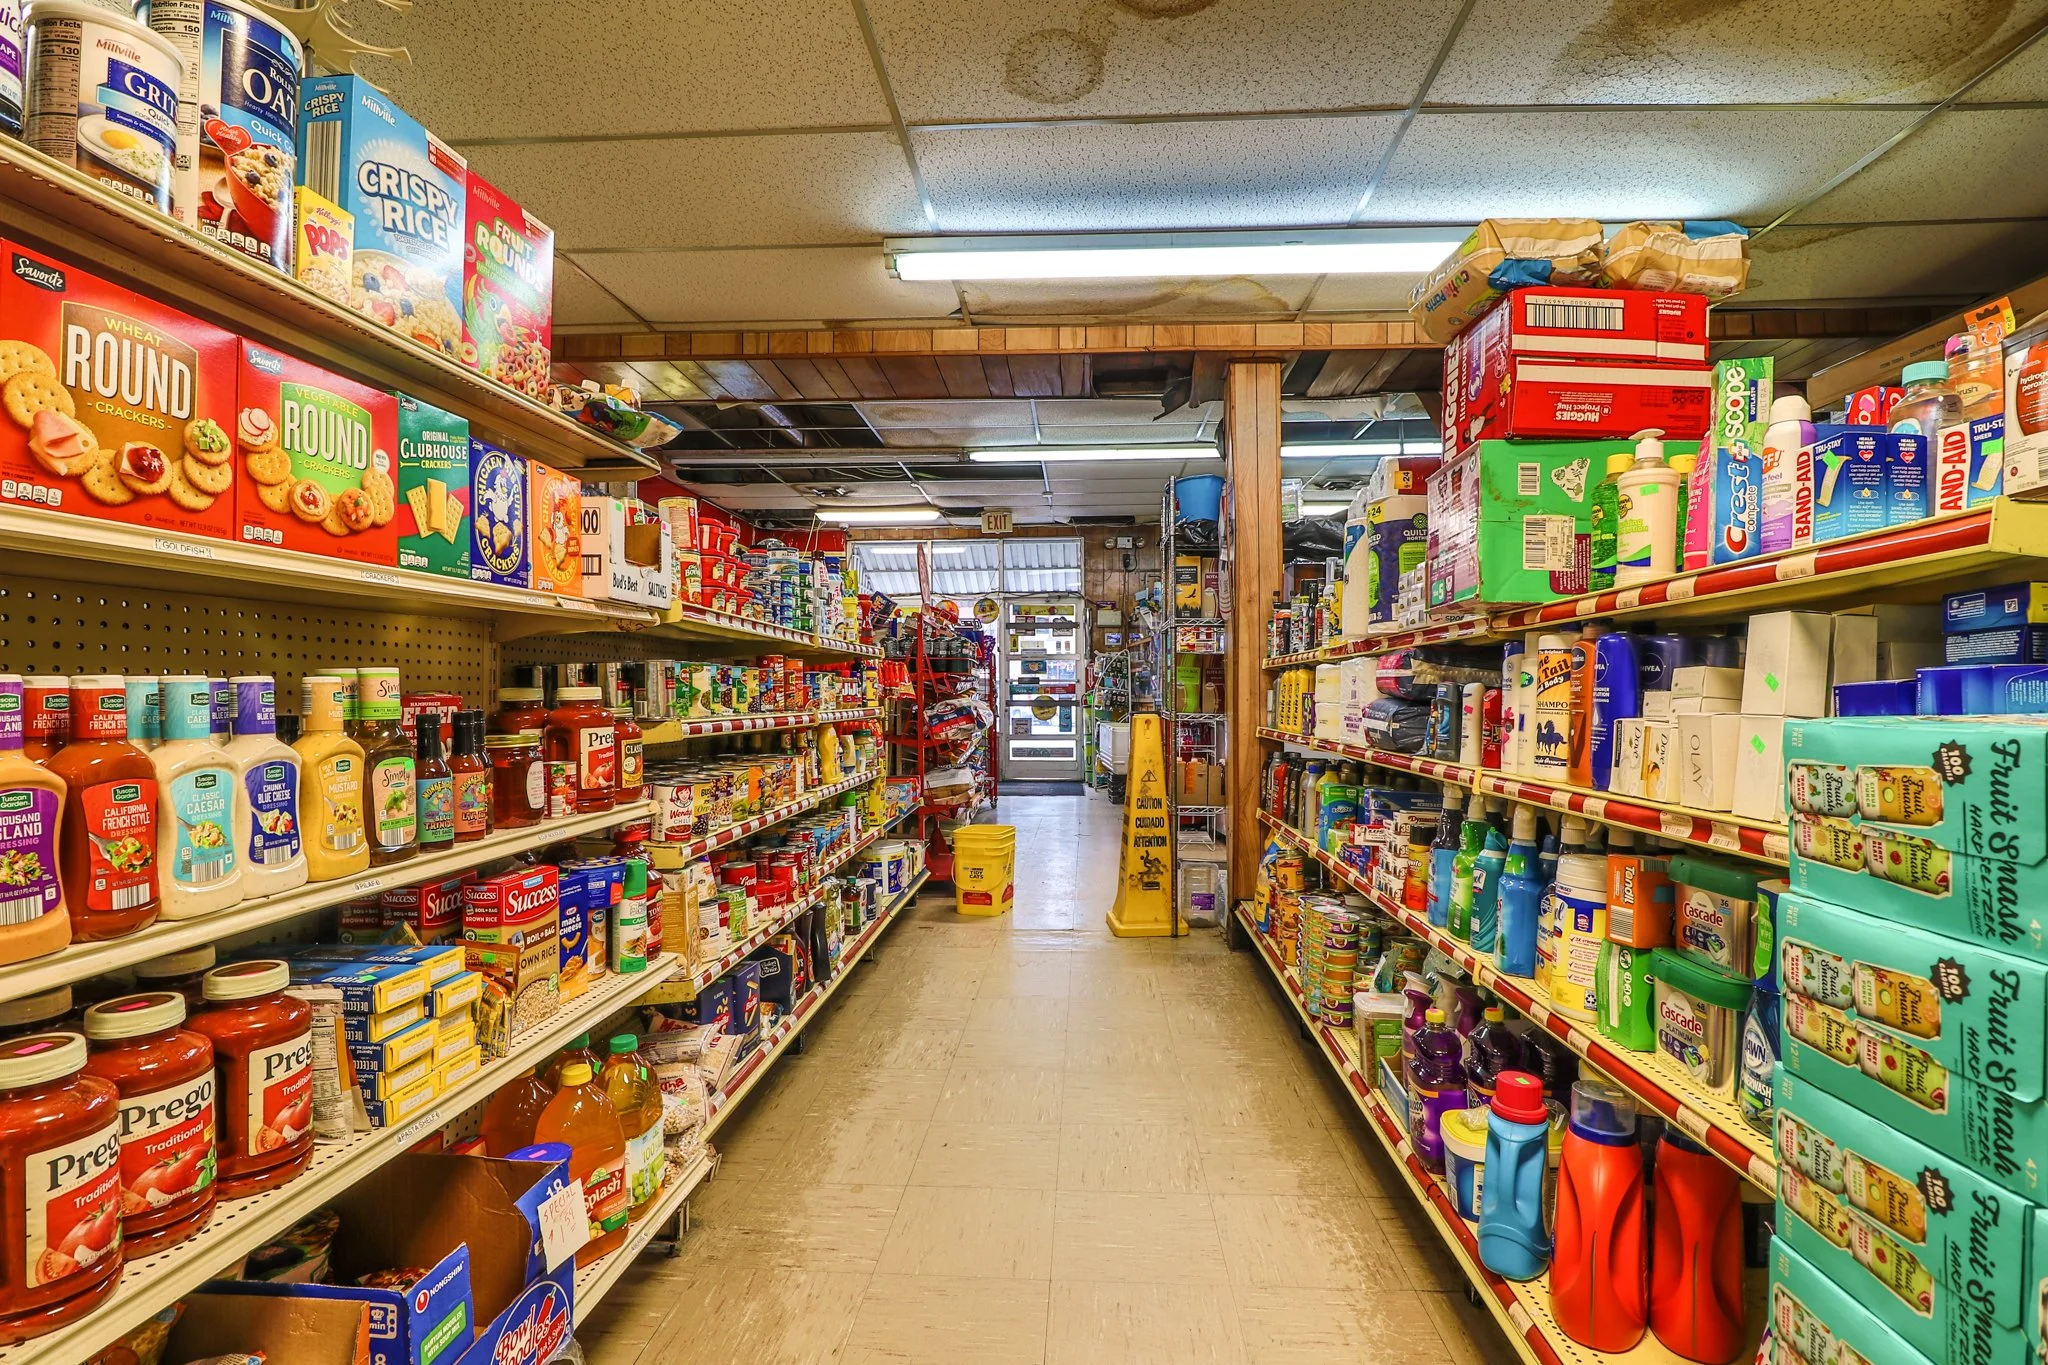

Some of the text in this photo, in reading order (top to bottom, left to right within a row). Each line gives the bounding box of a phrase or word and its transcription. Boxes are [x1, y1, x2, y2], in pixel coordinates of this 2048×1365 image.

[180, 2, 200, 10] Facts
[183, 25, 200, 34] 150
[61, 46, 79, 55] 130
[96, 39, 141, 62] Millville
[304, 92, 345, 112] CRISPY
[312, 102, 340, 118] RICE
[362, 96, 396, 127] Millville
[148, 108, 170, 126] Quick
[251, 120, 282, 145] Quick
[358, 161, 459, 228] CRISPY
[473, 186, 501, 211] Millville
[381, 197, 451, 249] RICE
[304, 224, 349, 262] POPS
[494, 218, 534, 258] FRUIT
[477, 225, 544, 291] ROUNDS
[15, 258, 65, 288] Savoritz
[1425, 292, 1447, 313] Pants
[105, 316, 164, 348] WHEAT
[66, 324, 192, 420] ROUND
[250, 350, 282, 373] Savoritz
[1460, 336, 1468, 386] movers
[296, 387, 358, 418] VEGETABLE
[1443, 334, 1460, 463] HUGGIES
[1556, 402, 1600, 412] Project Hug
[1724, 366, 1746, 438] scope
[95, 401, 166, 431] CRACKERS
[1555, 410, 1600, 422] HUGGIES
[284, 399, 368, 470] ROUND
[422, 431, 450, 443] ORIGINAL
[1815, 438, 1844, 454] TRU-STAY
[1974, 432, 1992, 442] SHEER
[400, 438, 468, 460] CLUBHOUSE
[304, 460, 350, 480] CRACKERS
[421, 460, 452, 470] CRACKERS
[1768, 472, 1783, 480] feel
[478, 456, 504, 506] CHICKEN
[1795, 450, 1811, 540] BAND-AID
[1726, 460, 1750, 555] Crest
[1746, 486, 1758, 532] complete
[987, 515, 1008, 530] EXIT
[480, 538, 521, 571] CRACKERS
[366, 572, 395, 583] CRACKERS
[544, 552, 576, 582] CRACKERS
[612, 572, 638, 593] Bud's Best
[1542, 658, 1570, 680] Tail
[1640, 665, 1661, 673] NIVEA
[1544, 676, 1564, 688] Body
[102, 702, 125, 710] Garden
[33, 720, 58, 729] FRENCH
[90, 720, 113, 730] FRENCH
[1632, 726, 1640, 760] Dove
[1660, 732, 1668, 765] Dove
[266, 767, 282, 775] Tuscan
[1690, 734, 1704, 794] OLAY
[1941, 748, 1953, 781] CALORIES
[1951, 750, 1964, 776] 100
[196, 775, 216, 784] Tuscan
[196, 781, 216, 789] Garden
[266, 772, 283, 780] Garden
[382, 768, 411, 788] Simply
[114, 794, 139, 802] Garden
[115, 787, 136, 796] Tuscan
[192, 791, 220, 802] CLASSIC
[258, 790, 292, 804] BLUE CHEESE
[262, 784, 286, 792] CHUNKY
[328, 782, 359, 794] MUSTARD
[1825, 772, 1834, 814] Smash
[1834, 778, 1844, 808] Fruit
[1901, 774, 1911, 821] Smash
[1916, 779, 1925, 816] Fruit
[104, 804, 148, 817] CALIFORNIA
[186, 800, 225, 814] CAESAR
[191, 810, 222, 820] DRESSING
[262, 802, 290, 811] DRESSING
[1136, 798, 1162, 810] CAUTION
[102, 812, 151, 831] FRENCH STYLE
[110, 826, 147, 838] DRESSING
[1135, 816, 1164, 828] CUIDADO
[1134, 836, 1167, 848] ATTENTION
[1829, 824, 1840, 864] Smash
[1841, 828, 1850, 860] Fruit
[1988, 739, 2026, 946] Fruit Smash
[1909, 842, 1919, 885] Smash
[1918, 846, 1930, 886] Fruit
[1968, 804, 1992, 940] HARD SELTZER
[360, 880, 377, 889] PILAF
[466, 890, 496, 900] Success
[1623, 866, 1636, 904] Tandil
[384, 892, 418, 904] Success
[506, 884, 556, 916] Success
[1720, 898, 1729, 908] 36
[1684, 902, 1723, 928] Cascade
[1692, 921, 1712, 932] PLATINUM
[526, 926, 556, 945] BOIL BAG
[542, 944, 556, 958] RICE
[1820, 958, 1830, 1000] Smash
[1829, 960, 1840, 1001] Fruit
[1938, 962, 1950, 1000] CALORIES
[1949, 968, 1962, 996] 100
[1899, 981, 1910, 1028] Smash
[1911, 988, 1922, 1026] Fruit
[1660, 1002, 1702, 1036] Cascade
[1666, 1023, 1692, 1042] PLATINUM
[1986, 970, 2021, 1178] Fruit Smash
[120, 1080, 212, 1137] Prego
[1967, 1027, 1992, 1167] HARD SELTZER
[144, 1120, 204, 1156] Traditional
[401, 1114, 436, 1143] PASTA SHELF
[544, 1187, 576, 1223] SPECIAL
[1970, 1190, 2000, 1280] Fruit
[430, 1262, 464, 1297] NONGSHIM
[441, 1311, 464, 1334] NOODLES
[452, 1321, 460, 1335] MIX
[498, 1304, 536, 1360] Bowl
[552, 1321, 564, 1341] Spicy
